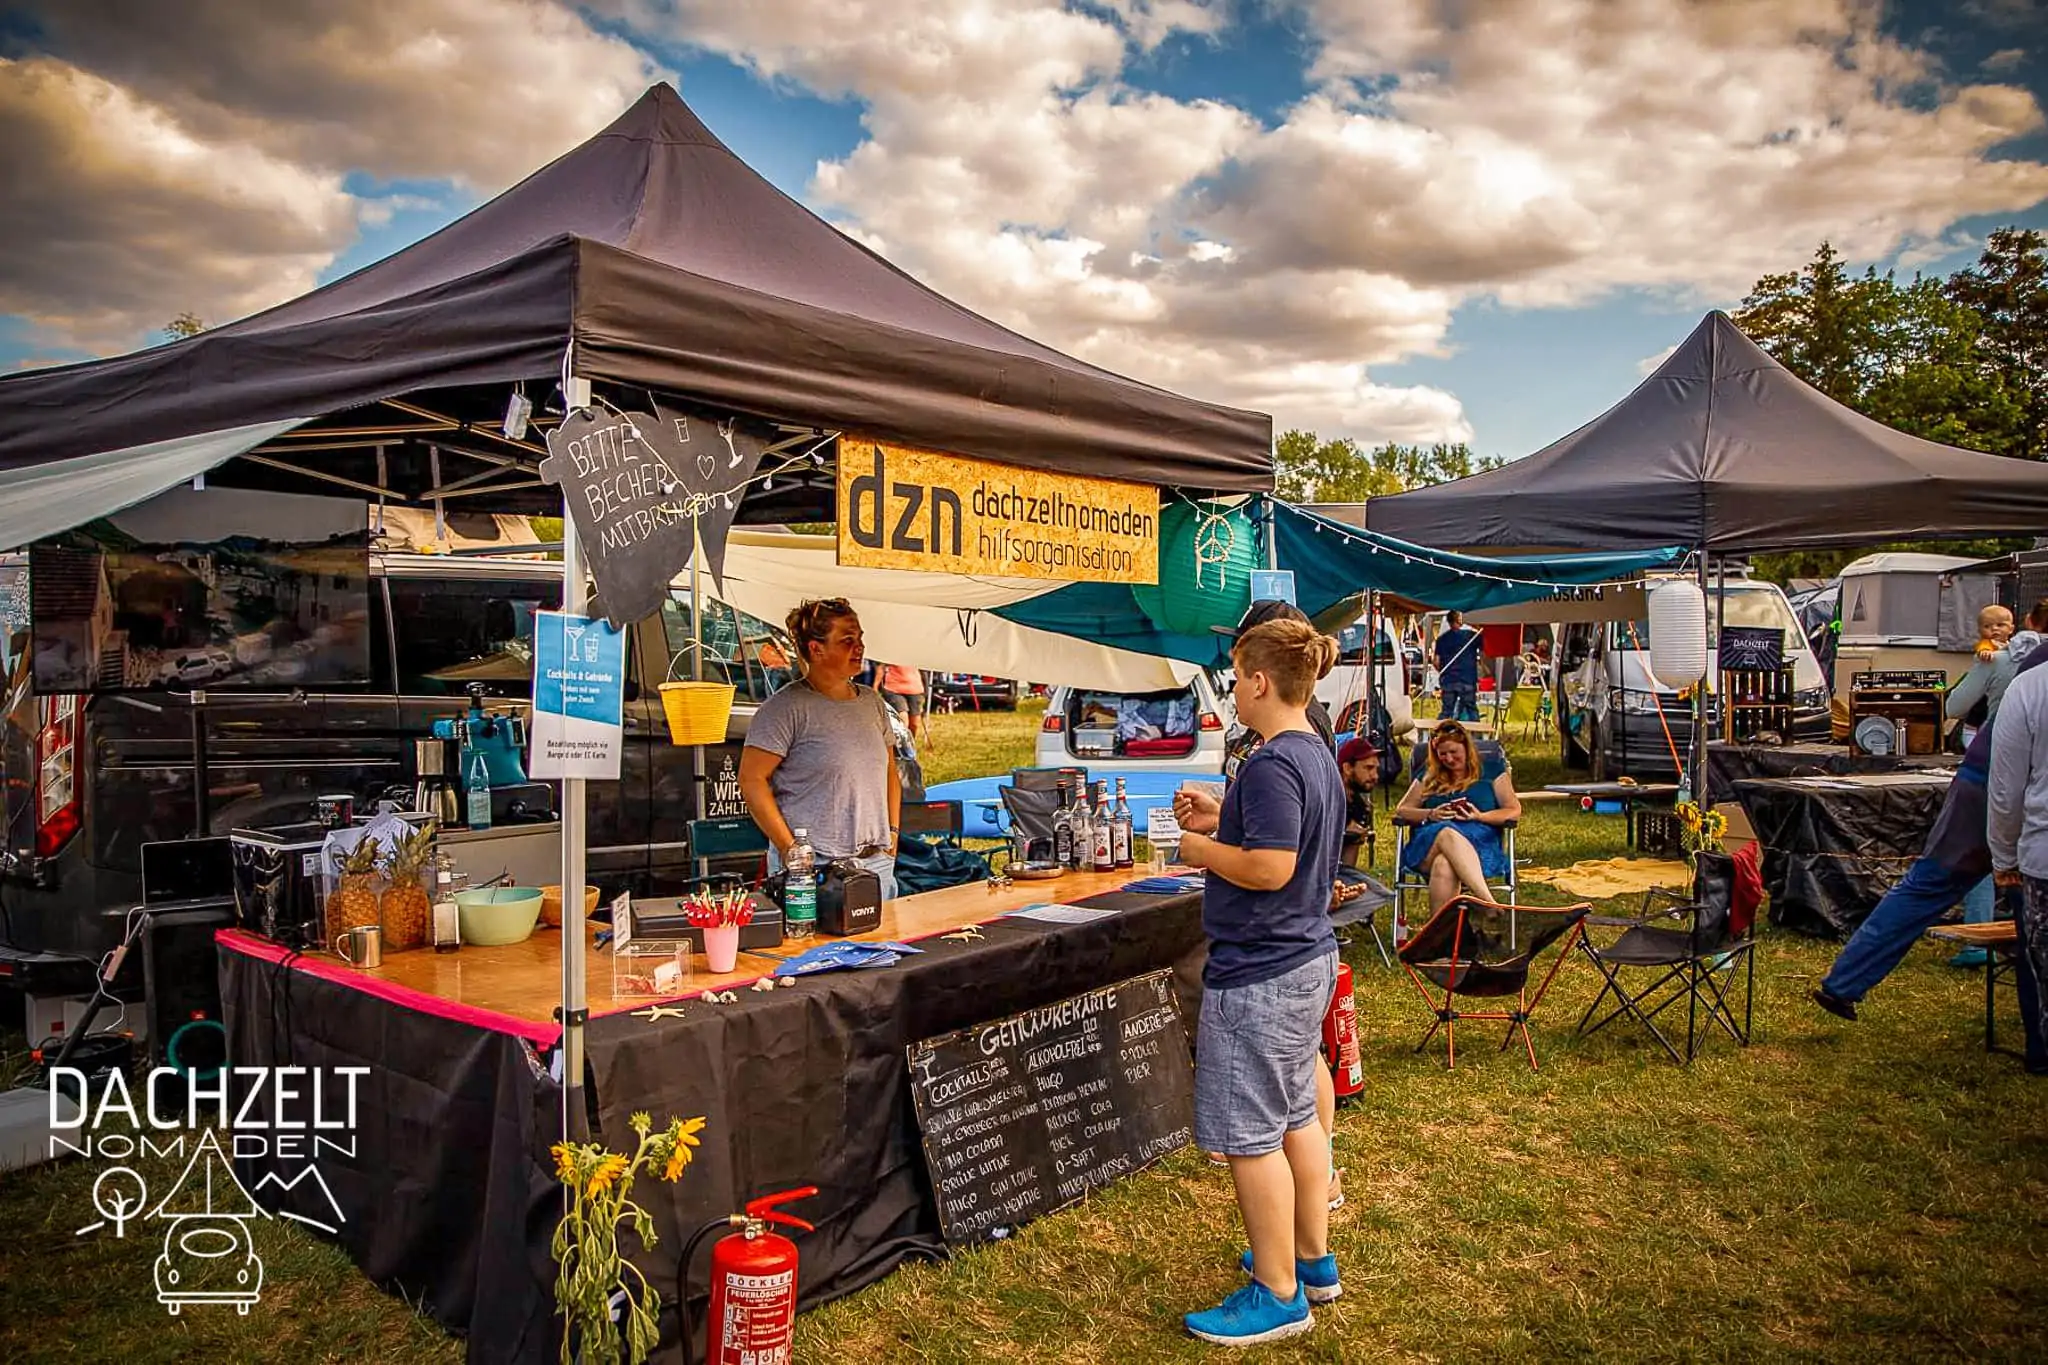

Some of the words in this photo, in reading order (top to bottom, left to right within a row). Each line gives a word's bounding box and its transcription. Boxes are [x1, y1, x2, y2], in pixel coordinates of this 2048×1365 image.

[568, 423, 638, 478] BITTE
[585, 463, 674, 523] BECHER
[849, 444, 962, 556] dzn
[972, 480, 1153, 538] dachzeltnomaden
[602, 493, 717, 558] MITBRINGEN
[979, 526, 1132, 572] hilfsorganisation
[546, 668, 577, 681] Cockils
[560, 683, 578, 692] Tnken
[546, 750, 569, 760] Barged
[719, 771, 737, 781] DAS
[713, 781, 742, 801] WIR
[851, 906, 876, 918] VONYX
[1123, 1012, 1162, 1038] ANDERE
[1027, 1036, 1086, 1074] ALKOHOLFREI
[931, 1064, 991, 1103] COCKTAILS
[1036, 1072, 1064, 1092] HUGO
[1090, 1099, 1113, 1116] COLA
[966, 1133, 1005, 1160] COLADA
[1055, 1145, 1097, 1175] O-SAFT
[946, 1192, 978, 1215] HUGO
[990, 1178, 1010, 1197] GIN
